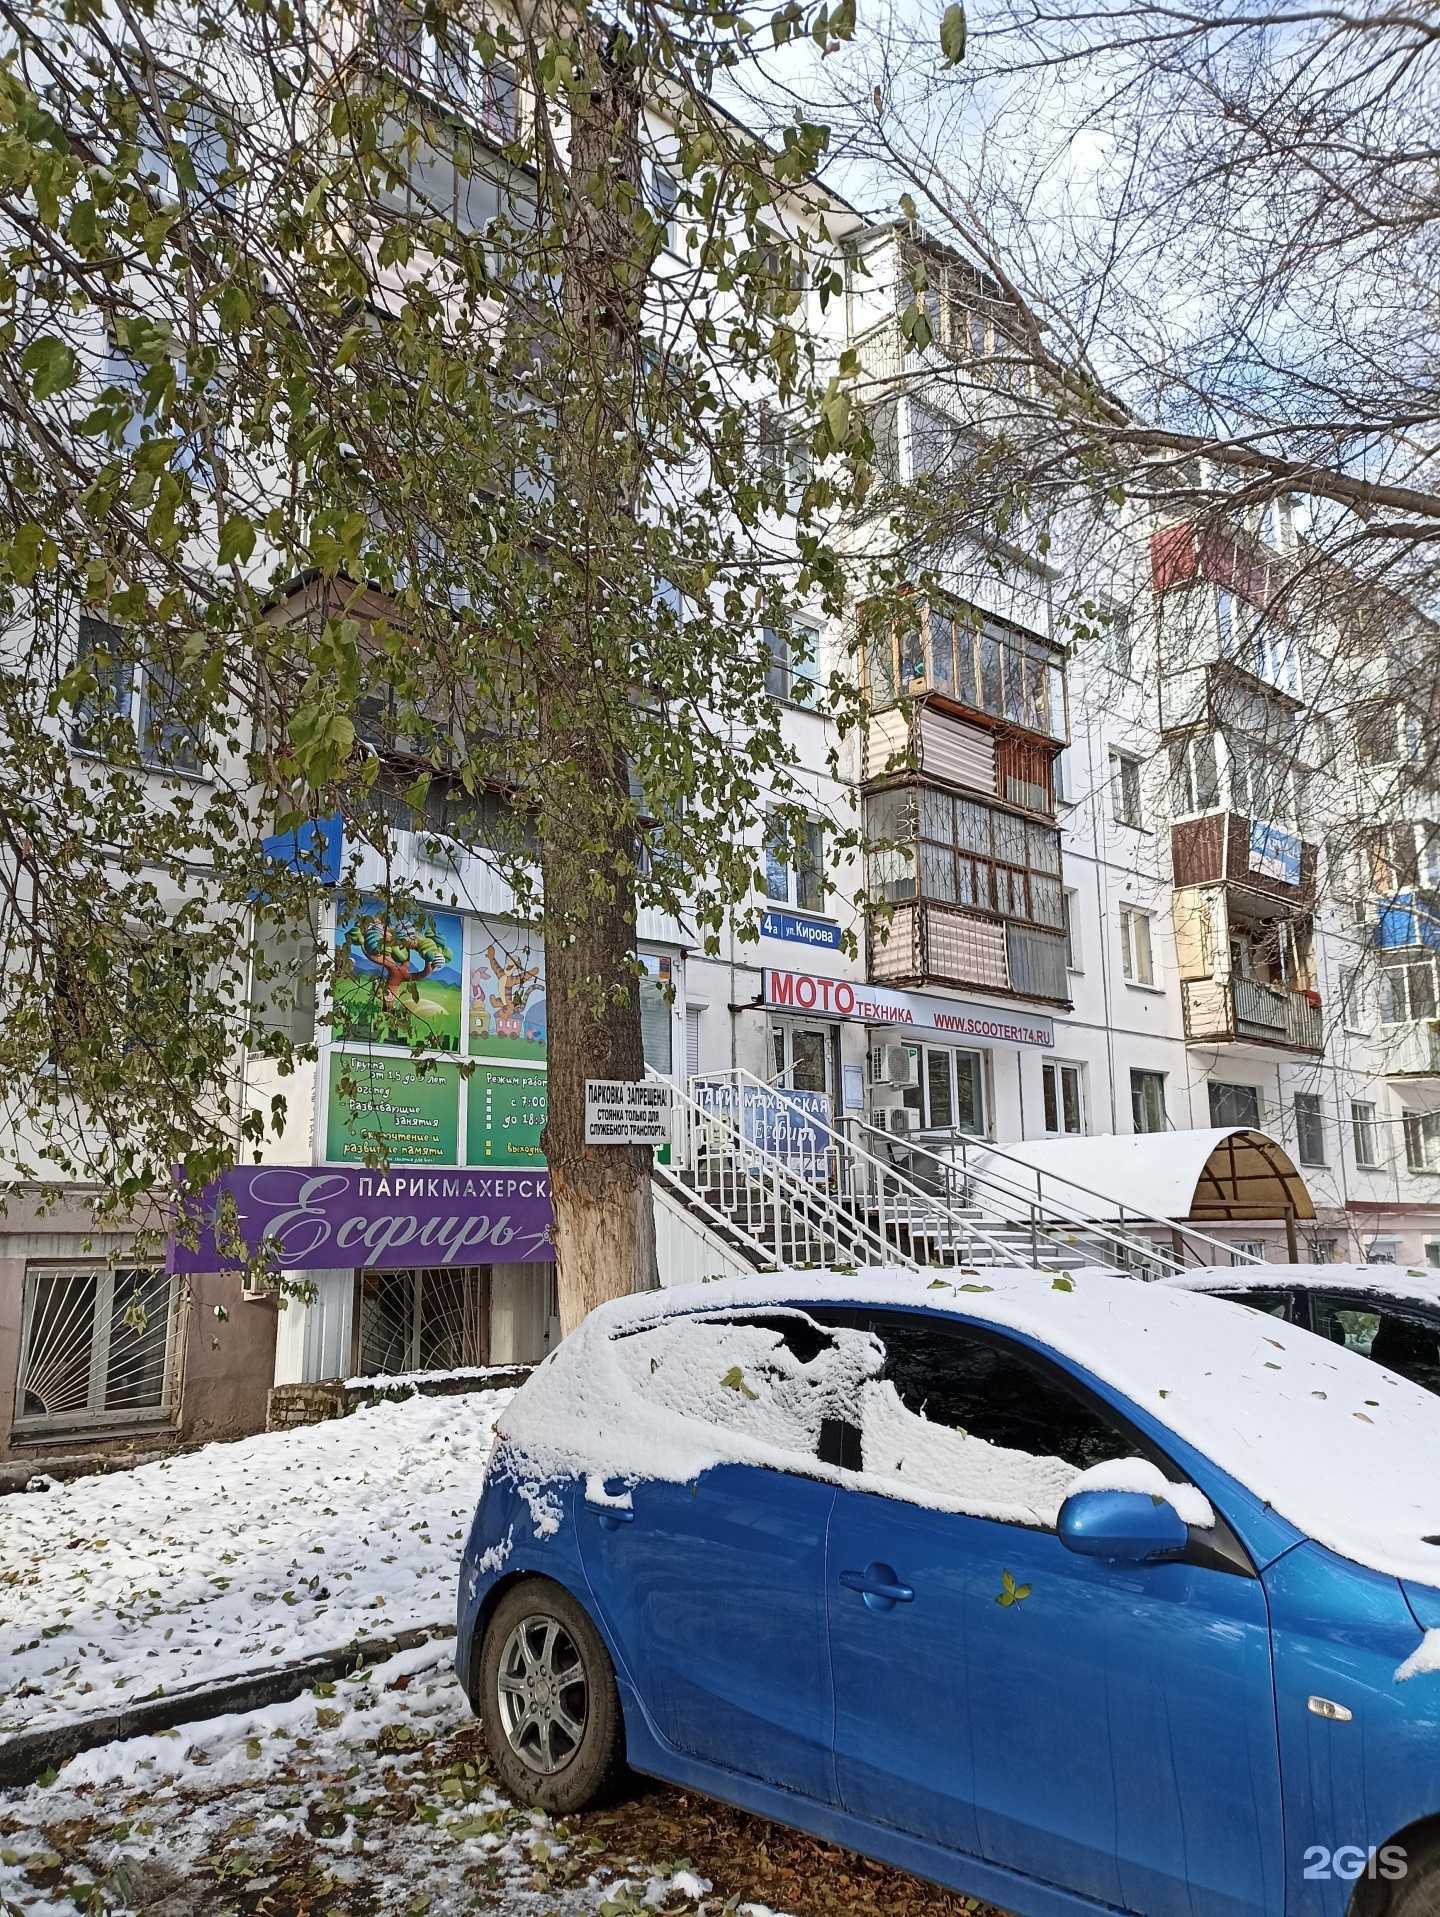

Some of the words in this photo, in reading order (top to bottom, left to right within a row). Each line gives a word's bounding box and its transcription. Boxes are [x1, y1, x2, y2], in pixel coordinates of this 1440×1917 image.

[764, 915, 778, 934] 4а
[786, 926, 796, 937] ул.
[796, 921, 834, 943] Кирова
[934, 1013, 1051, 1045] WWW.SCOOTER174.RU
[351, 1058, 385, 1072] Группа
[403, 1074, 415, 1085] до
[428, 1076, 447, 1085] лет
[486, 1072, 519, 1085] Режим
[522, 1075, 547, 1088] работ
[355, 1086, 391, 1098] огопед
[588, 1085, 623, 1104] ПАРКОВКА
[511, 1099, 517, 1107] с
[521, 1096, 546, 1107] 7:00
[394, 1116, 439, 1128] занятия
[502, 1114, 517, 1128] до
[522, 1113, 547, 1125] 18:3
[597, 1108, 624, 1121] СТОЯНКА
[625, 1110, 647, 1122] ТОЛЬКО
[648, 1111, 659, 1124] ДЛЯ
[590, 1124, 628, 1136] СЛУЖЕБНОГО
[432, 1134, 440, 1142] и
[401, 1145, 443, 1156] памяти
[507, 1142, 543, 1156] выходн
[358, 1177, 552, 1198] ПАРИКМАХЕРСК
[249, 1169, 522, 1266] Есфирь
